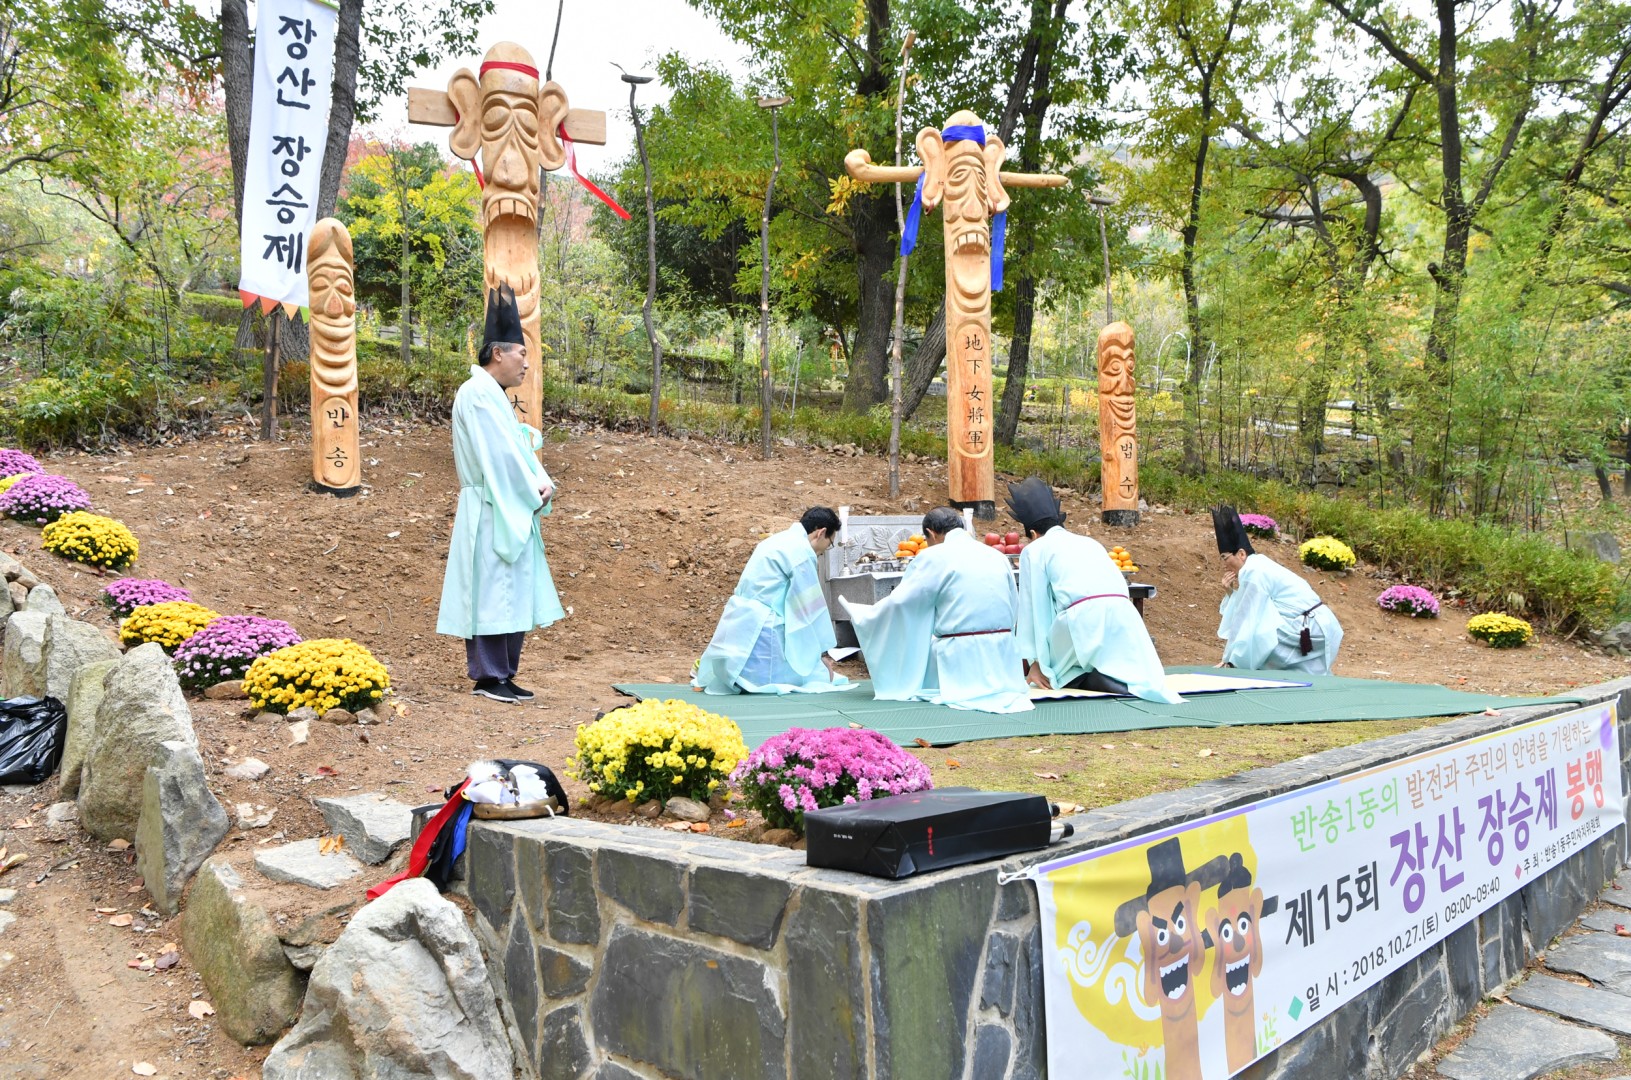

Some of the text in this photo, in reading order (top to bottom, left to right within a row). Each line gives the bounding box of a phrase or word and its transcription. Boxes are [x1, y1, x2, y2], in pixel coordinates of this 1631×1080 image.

[262, 15, 317, 274] 장산 장승제
[325, 406, 350, 468] 반송
[965, 333, 985, 449] 地下女將軍
[1119, 442, 1134, 493] 법수
[1290, 720, 1592, 852] 반송1동의 발전과 주민의 안녕을 기원하는
[1544, 815, 1602, 863] 반송1동주민자치위원회
[1285, 748, 1605, 948] 제15회 장산 장승제 봉행
[1352, 911, 1439, 982] 2018.10.27.(토)
[1444, 876, 1500, 923] 09:00~09:40
